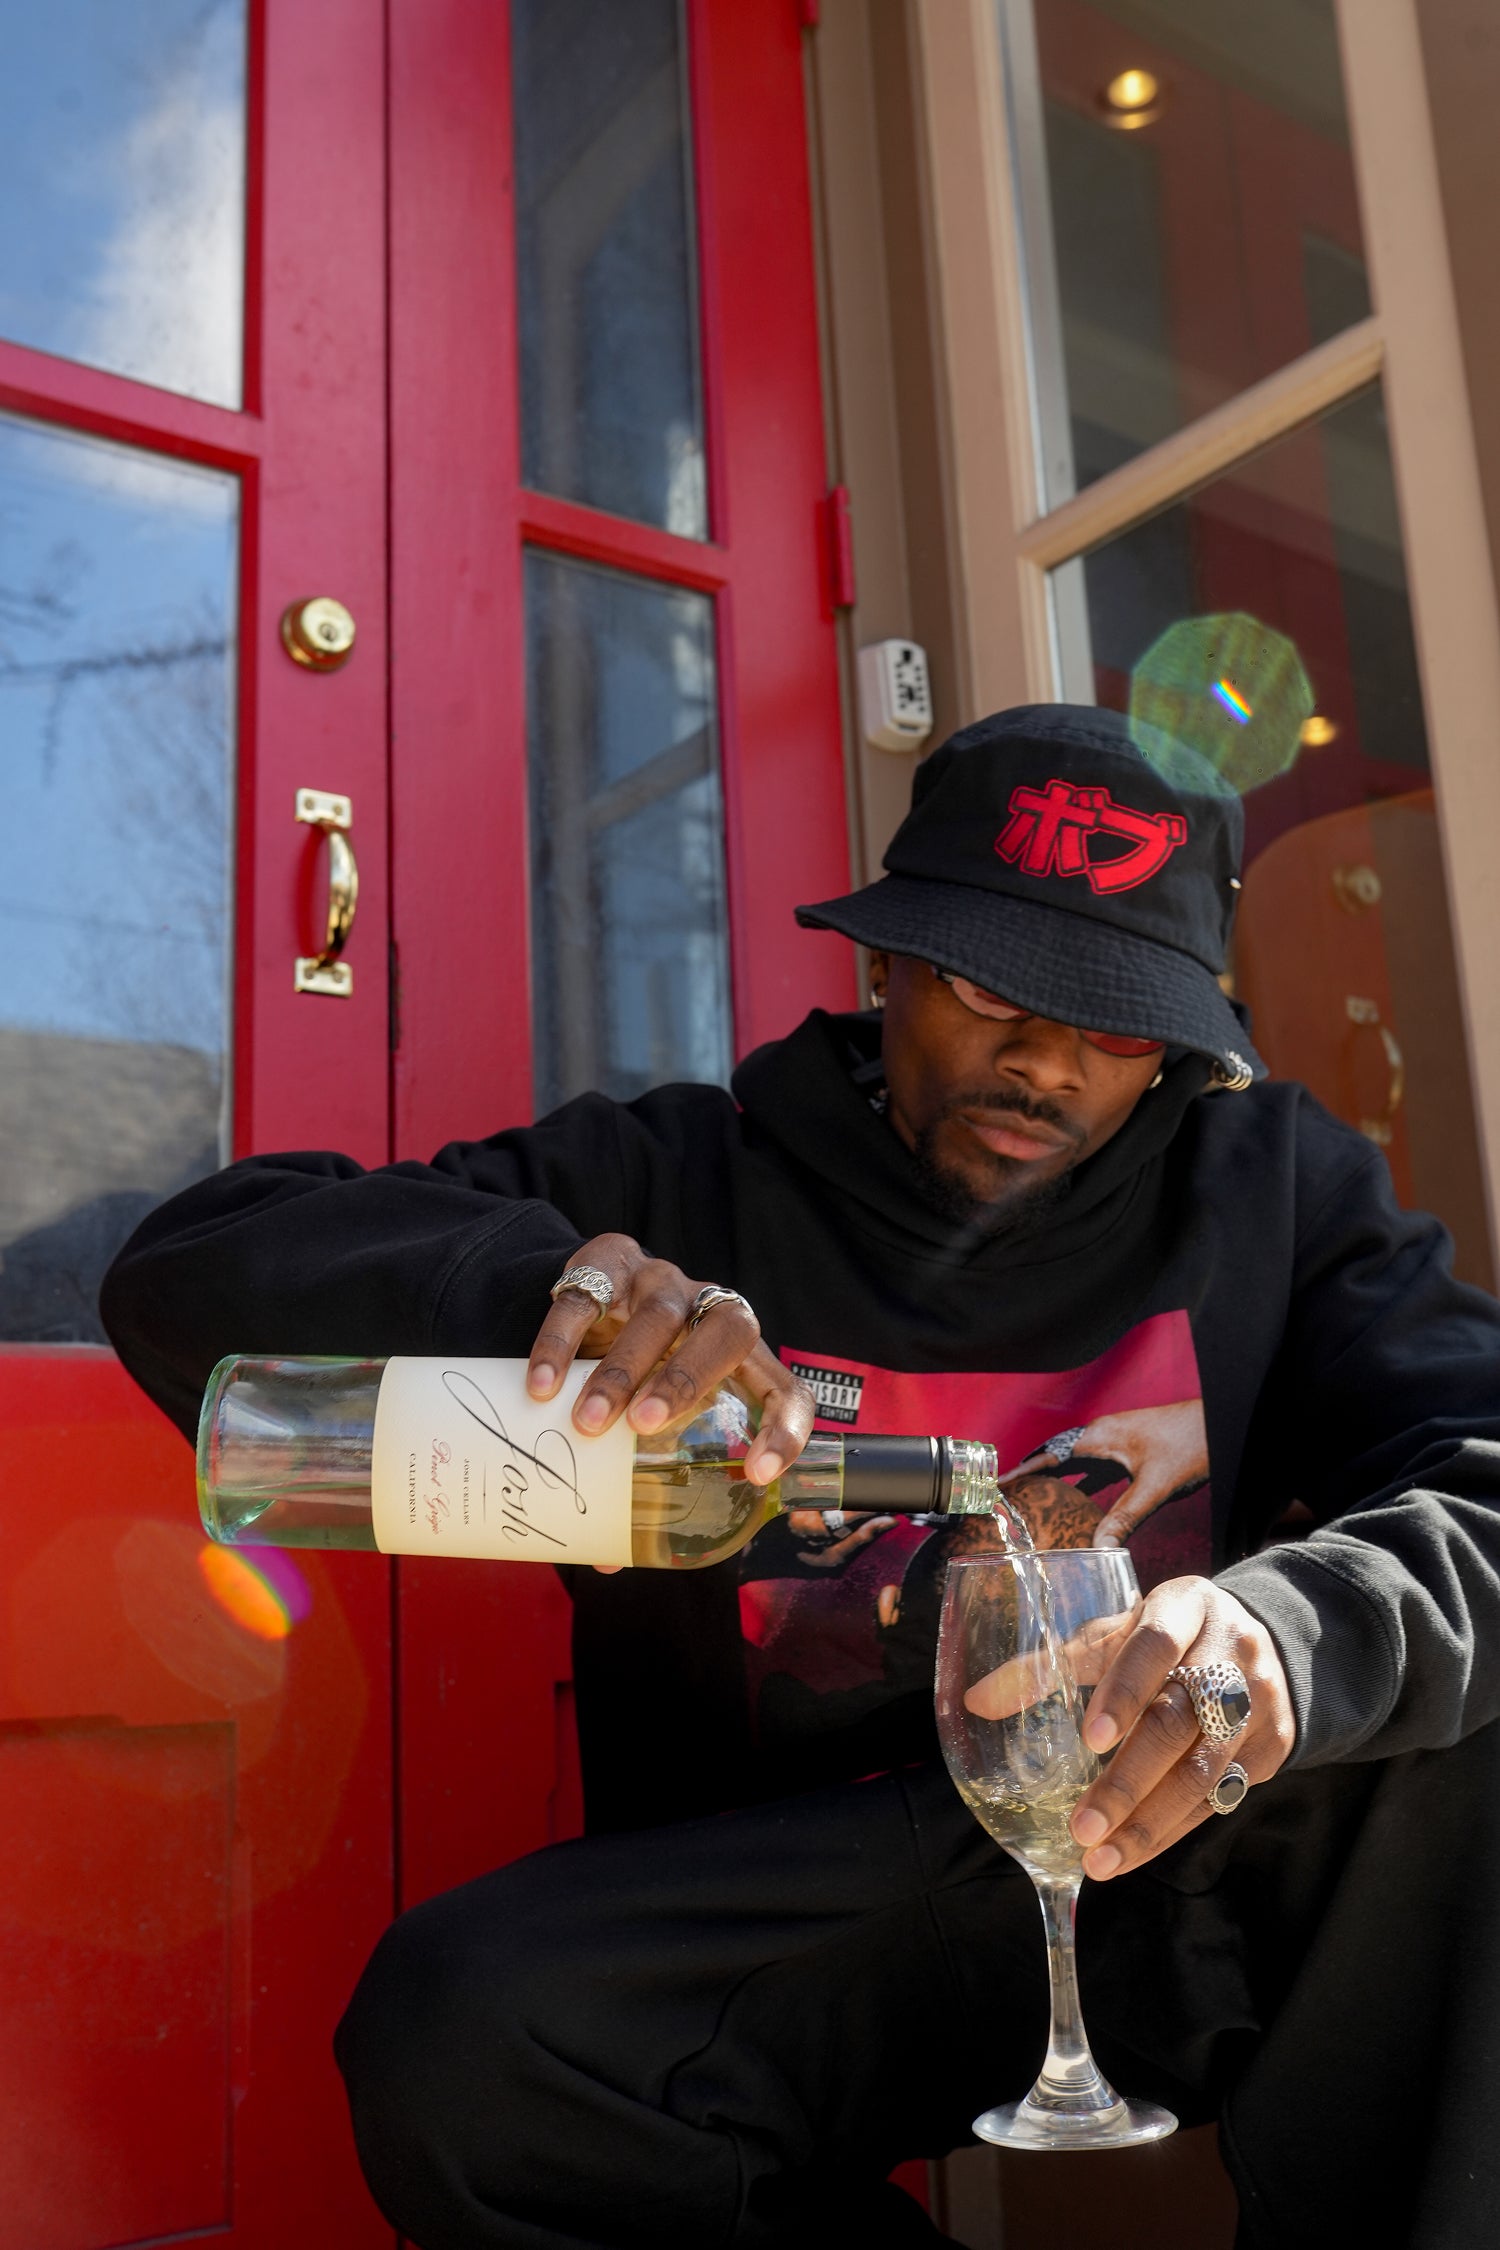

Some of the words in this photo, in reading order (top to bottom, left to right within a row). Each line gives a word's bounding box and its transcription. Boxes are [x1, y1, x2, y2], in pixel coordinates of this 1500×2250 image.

[792, 1365, 859, 1388] PARENTAL
[811, 1383, 858, 1407] ISORY
[820, 1405, 855, 1422] CONTENT
[430, 1438, 452, 1487] Pinot
[442, 1370, 587, 1547] Josh
[408, 1452, 417, 1524] CALIFORNIA
[423, 1492, 451, 1536] Grigio
